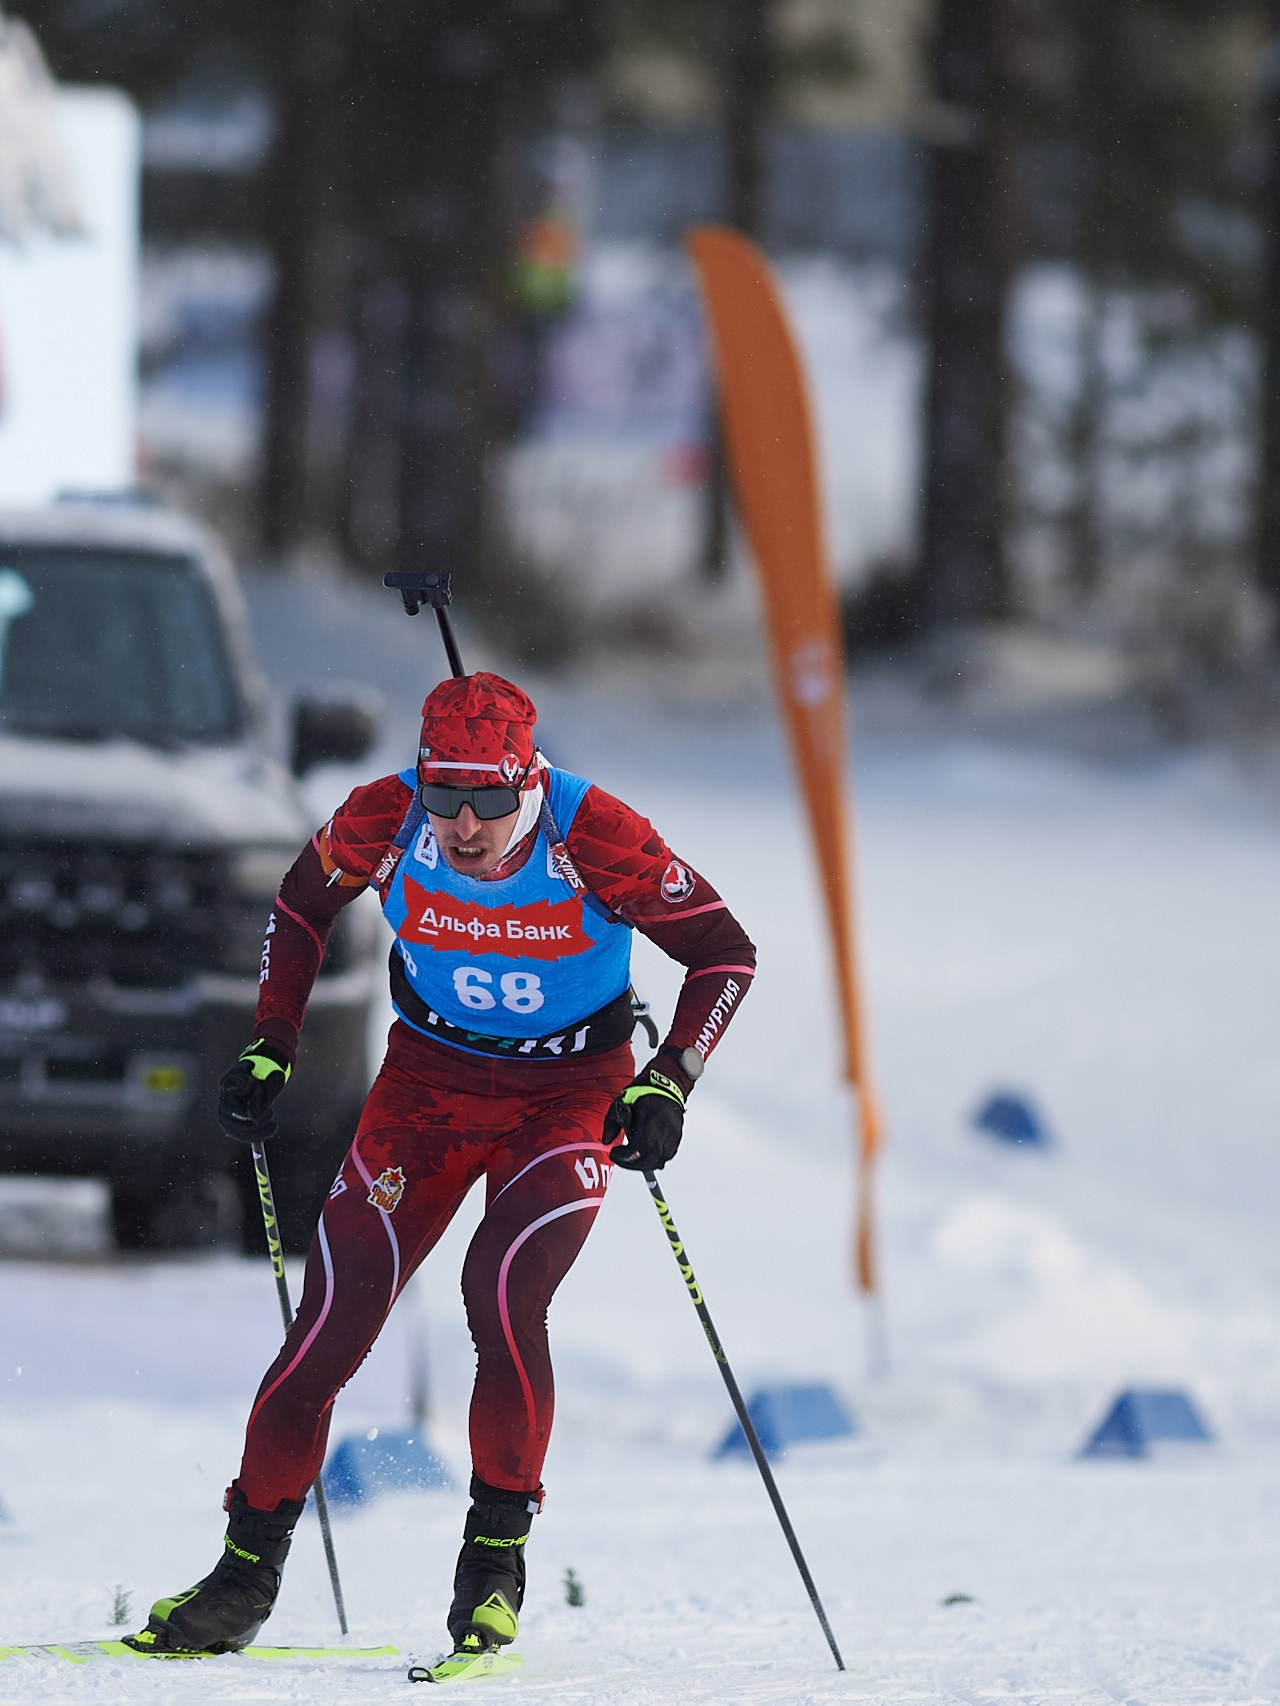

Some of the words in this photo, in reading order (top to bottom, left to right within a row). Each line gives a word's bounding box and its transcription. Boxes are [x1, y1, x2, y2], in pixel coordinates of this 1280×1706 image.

[418, 907, 501, 940] Альфа
[506, 919, 572, 940] Банк
[452, 966, 545, 1014] 68
[694, 976, 740, 1057] ДМУРТИЯ
[474, 1532, 529, 1547] FISCHE
